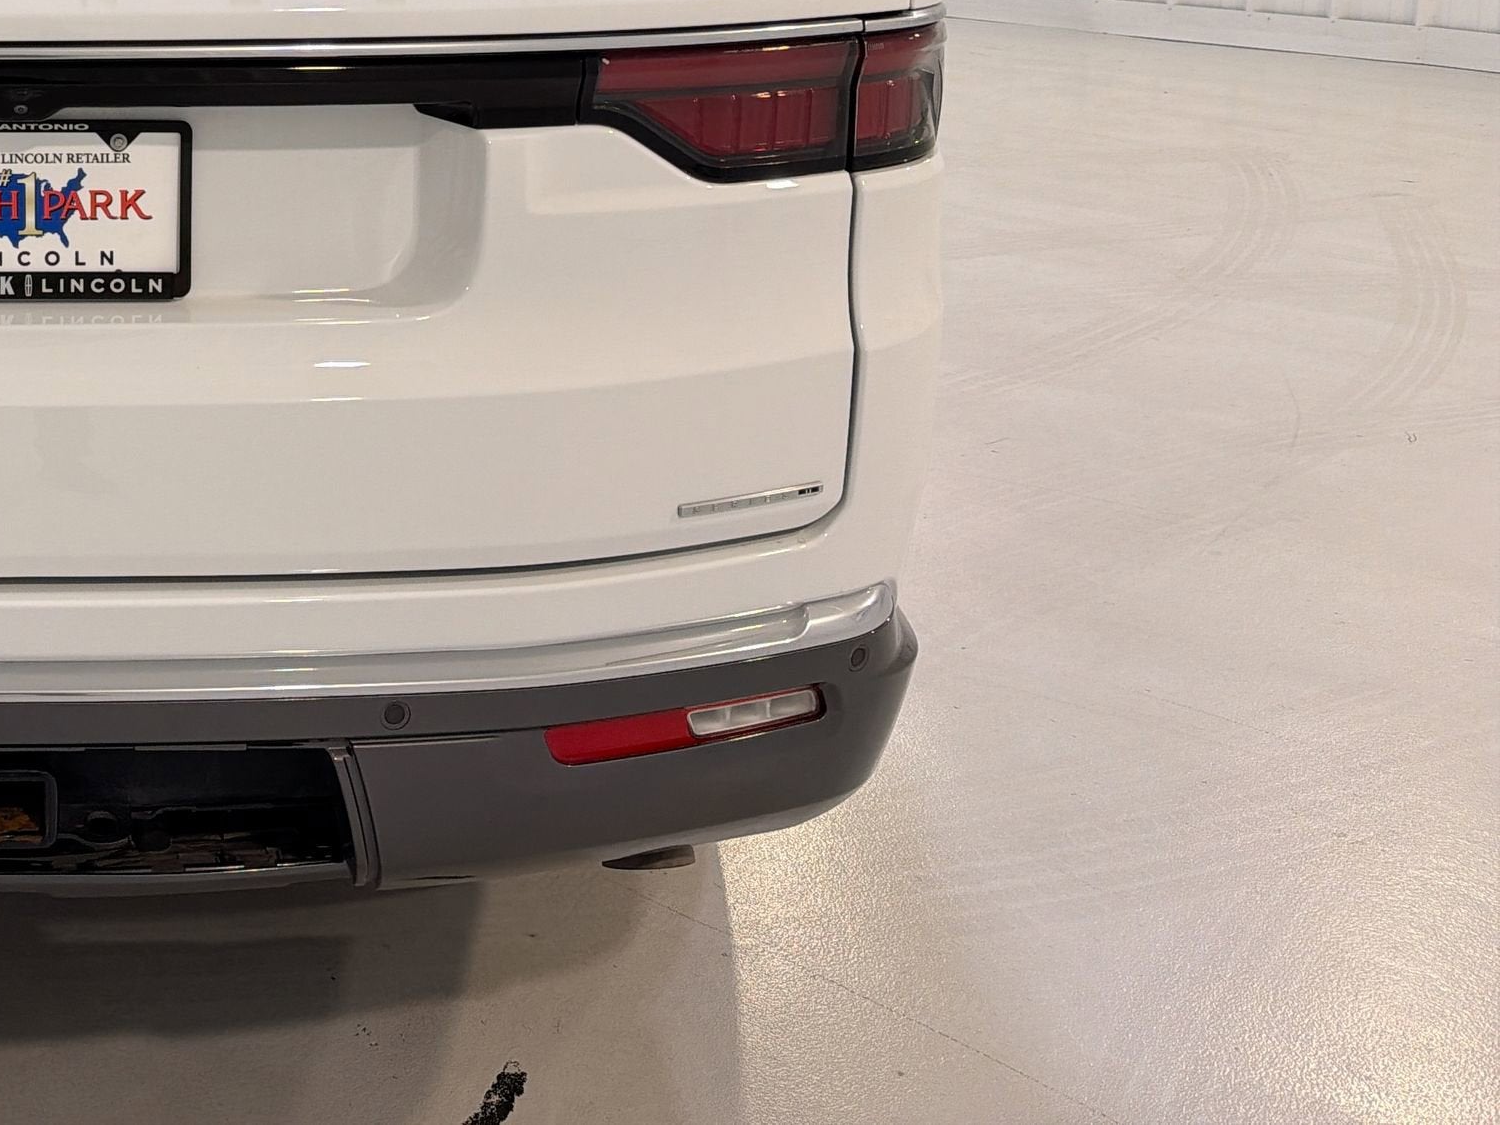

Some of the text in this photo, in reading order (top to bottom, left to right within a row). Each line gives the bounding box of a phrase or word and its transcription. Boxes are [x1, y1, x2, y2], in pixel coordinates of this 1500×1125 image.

[1, 152, 64, 165] LINCOLN
[66, 152, 132, 164] RETAILER
[42, 189, 153, 221] PARK
[40, 277, 163, 294] LINCOLN
